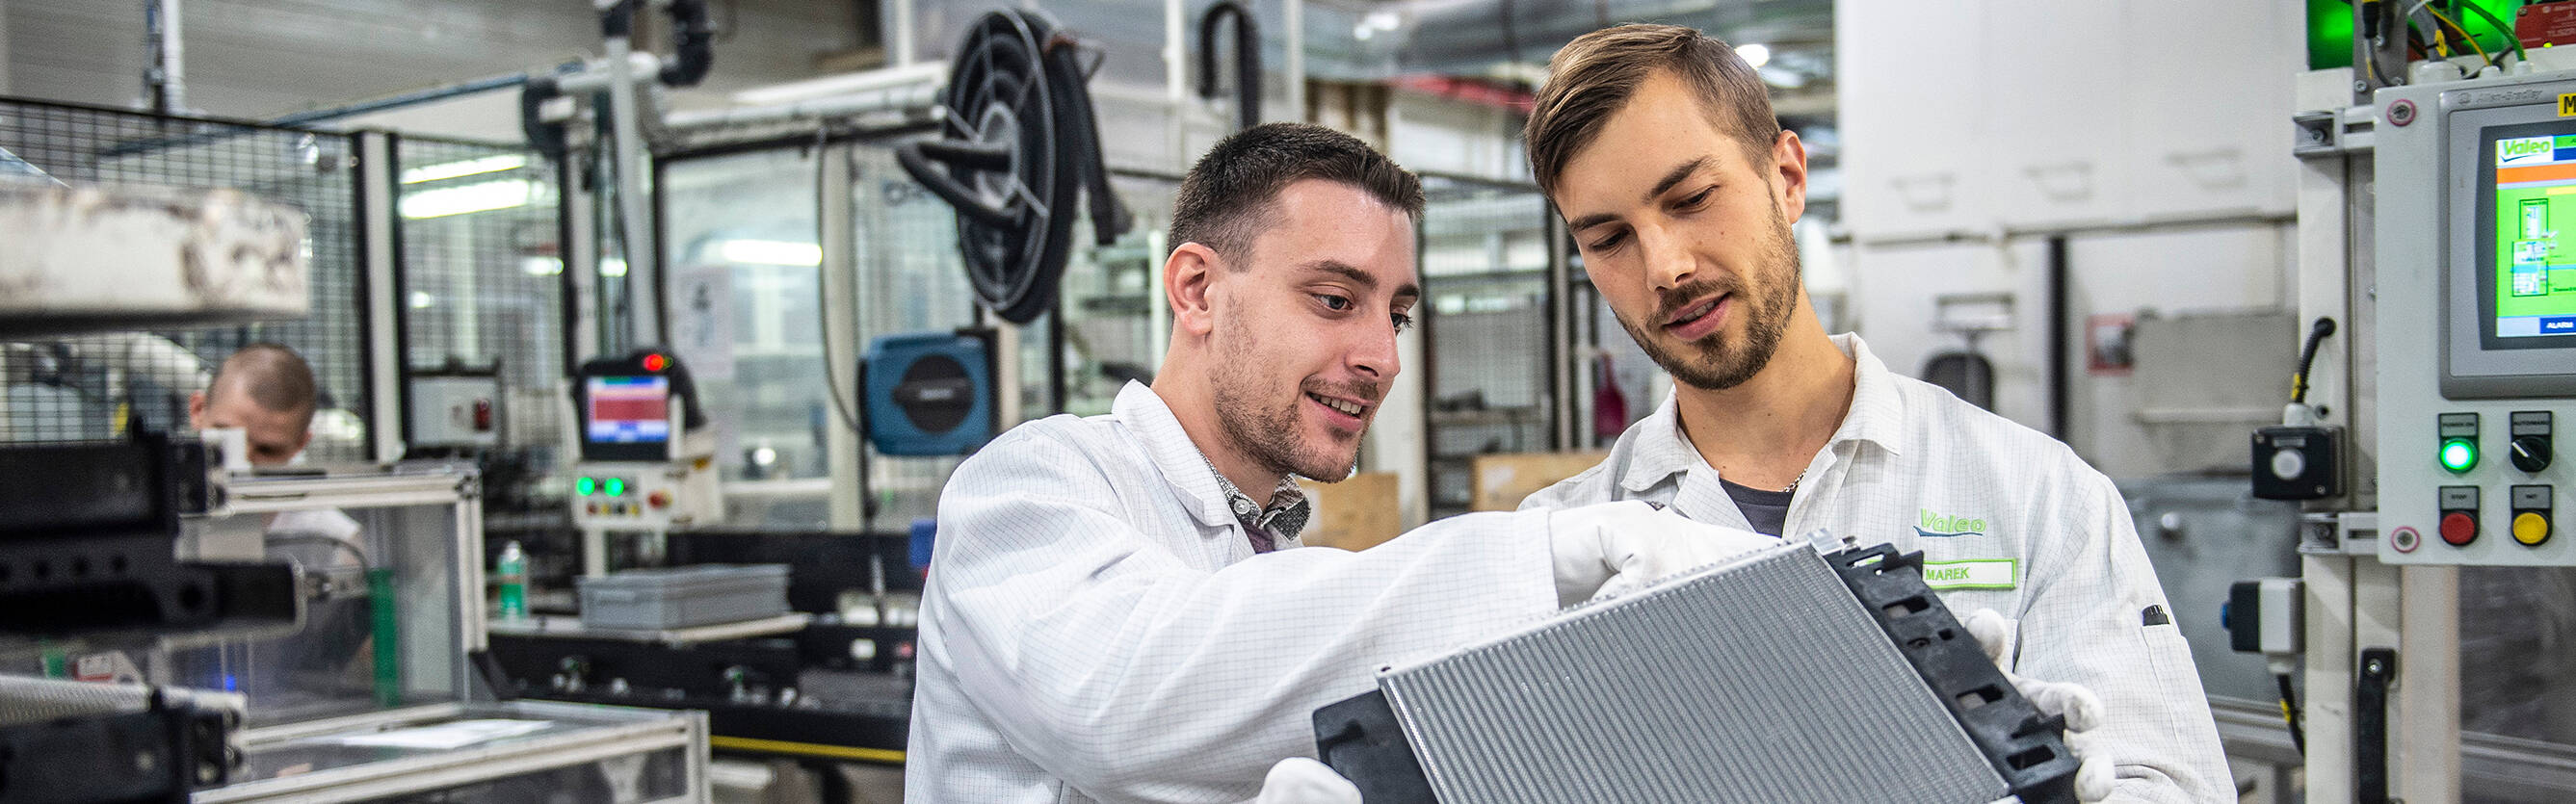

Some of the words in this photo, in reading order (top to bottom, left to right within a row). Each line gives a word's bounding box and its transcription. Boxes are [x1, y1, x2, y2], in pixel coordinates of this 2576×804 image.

[2503, 139, 2551, 155] Valeo
[1921, 507, 1986, 532] Valeo
[1926, 566, 1970, 581] MAREK
